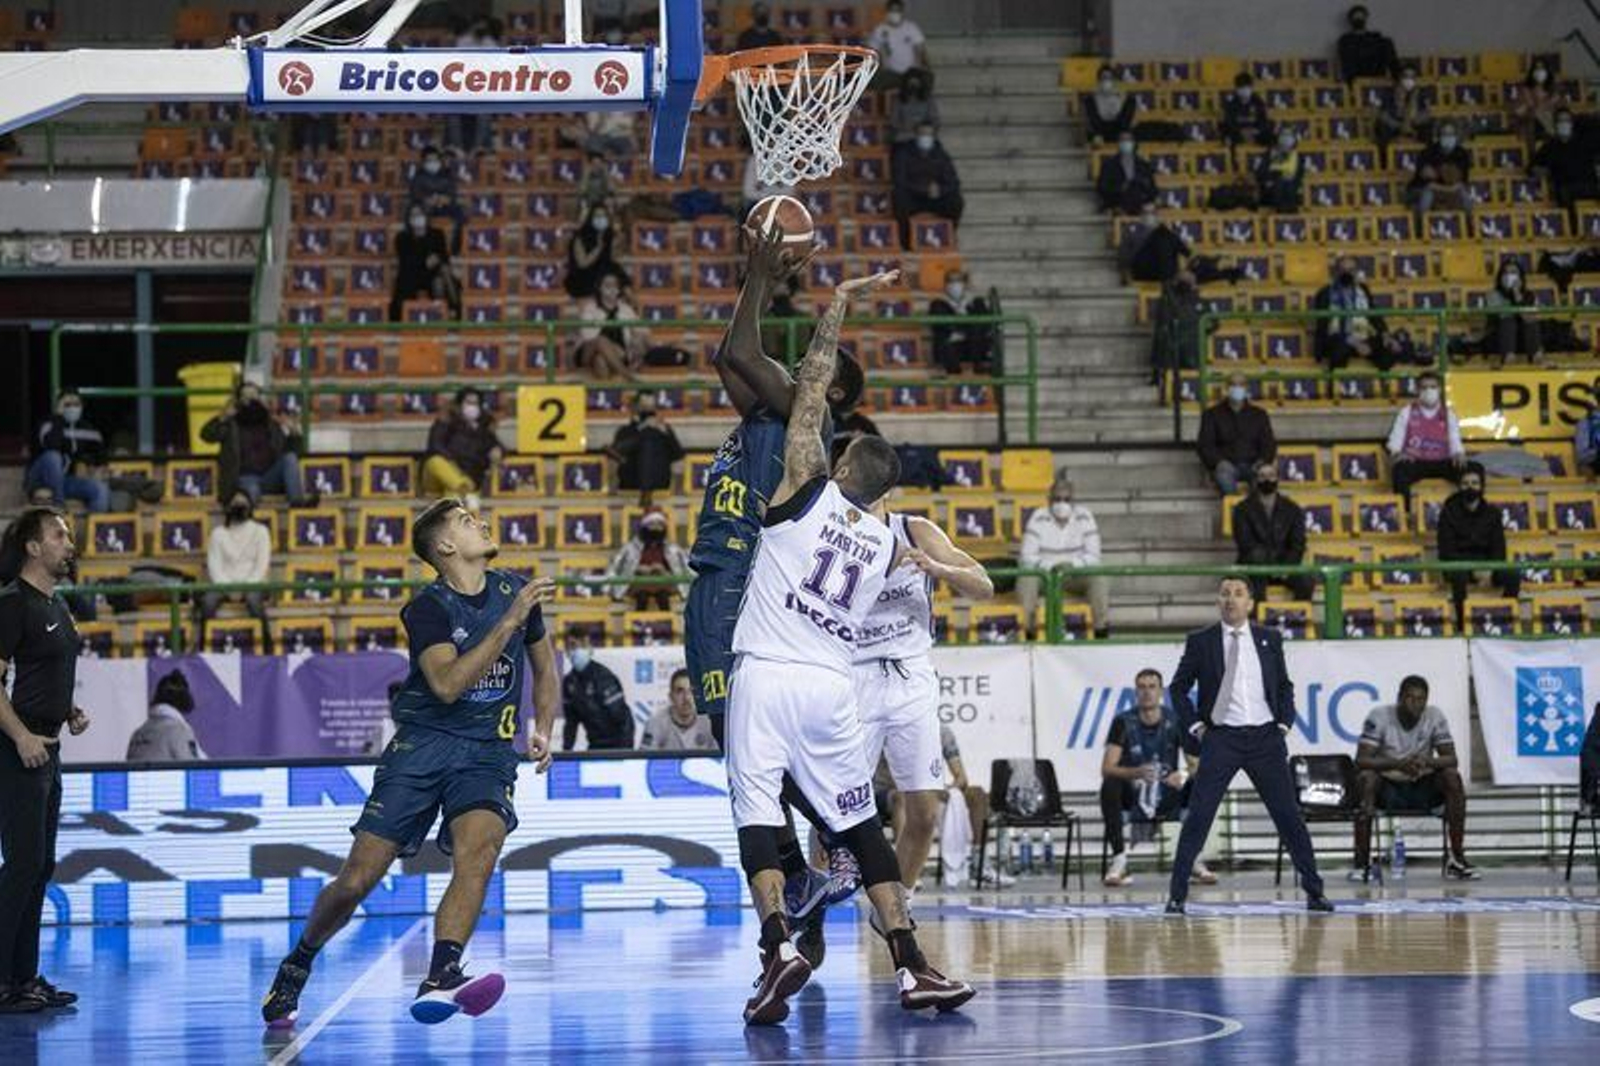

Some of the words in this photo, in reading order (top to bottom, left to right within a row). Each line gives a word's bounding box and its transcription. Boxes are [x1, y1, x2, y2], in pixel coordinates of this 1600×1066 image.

[339, 62, 572, 93] BricoCentro
[70, 237, 257, 260] EMERXENCIA
[537, 397, 568, 441] 2
[714, 475, 747, 517] 20
[799, 545, 864, 615] 11
[784, 592, 854, 643] IVECO
[702, 670, 726, 702] 20
[498, 704, 516, 739] 0
